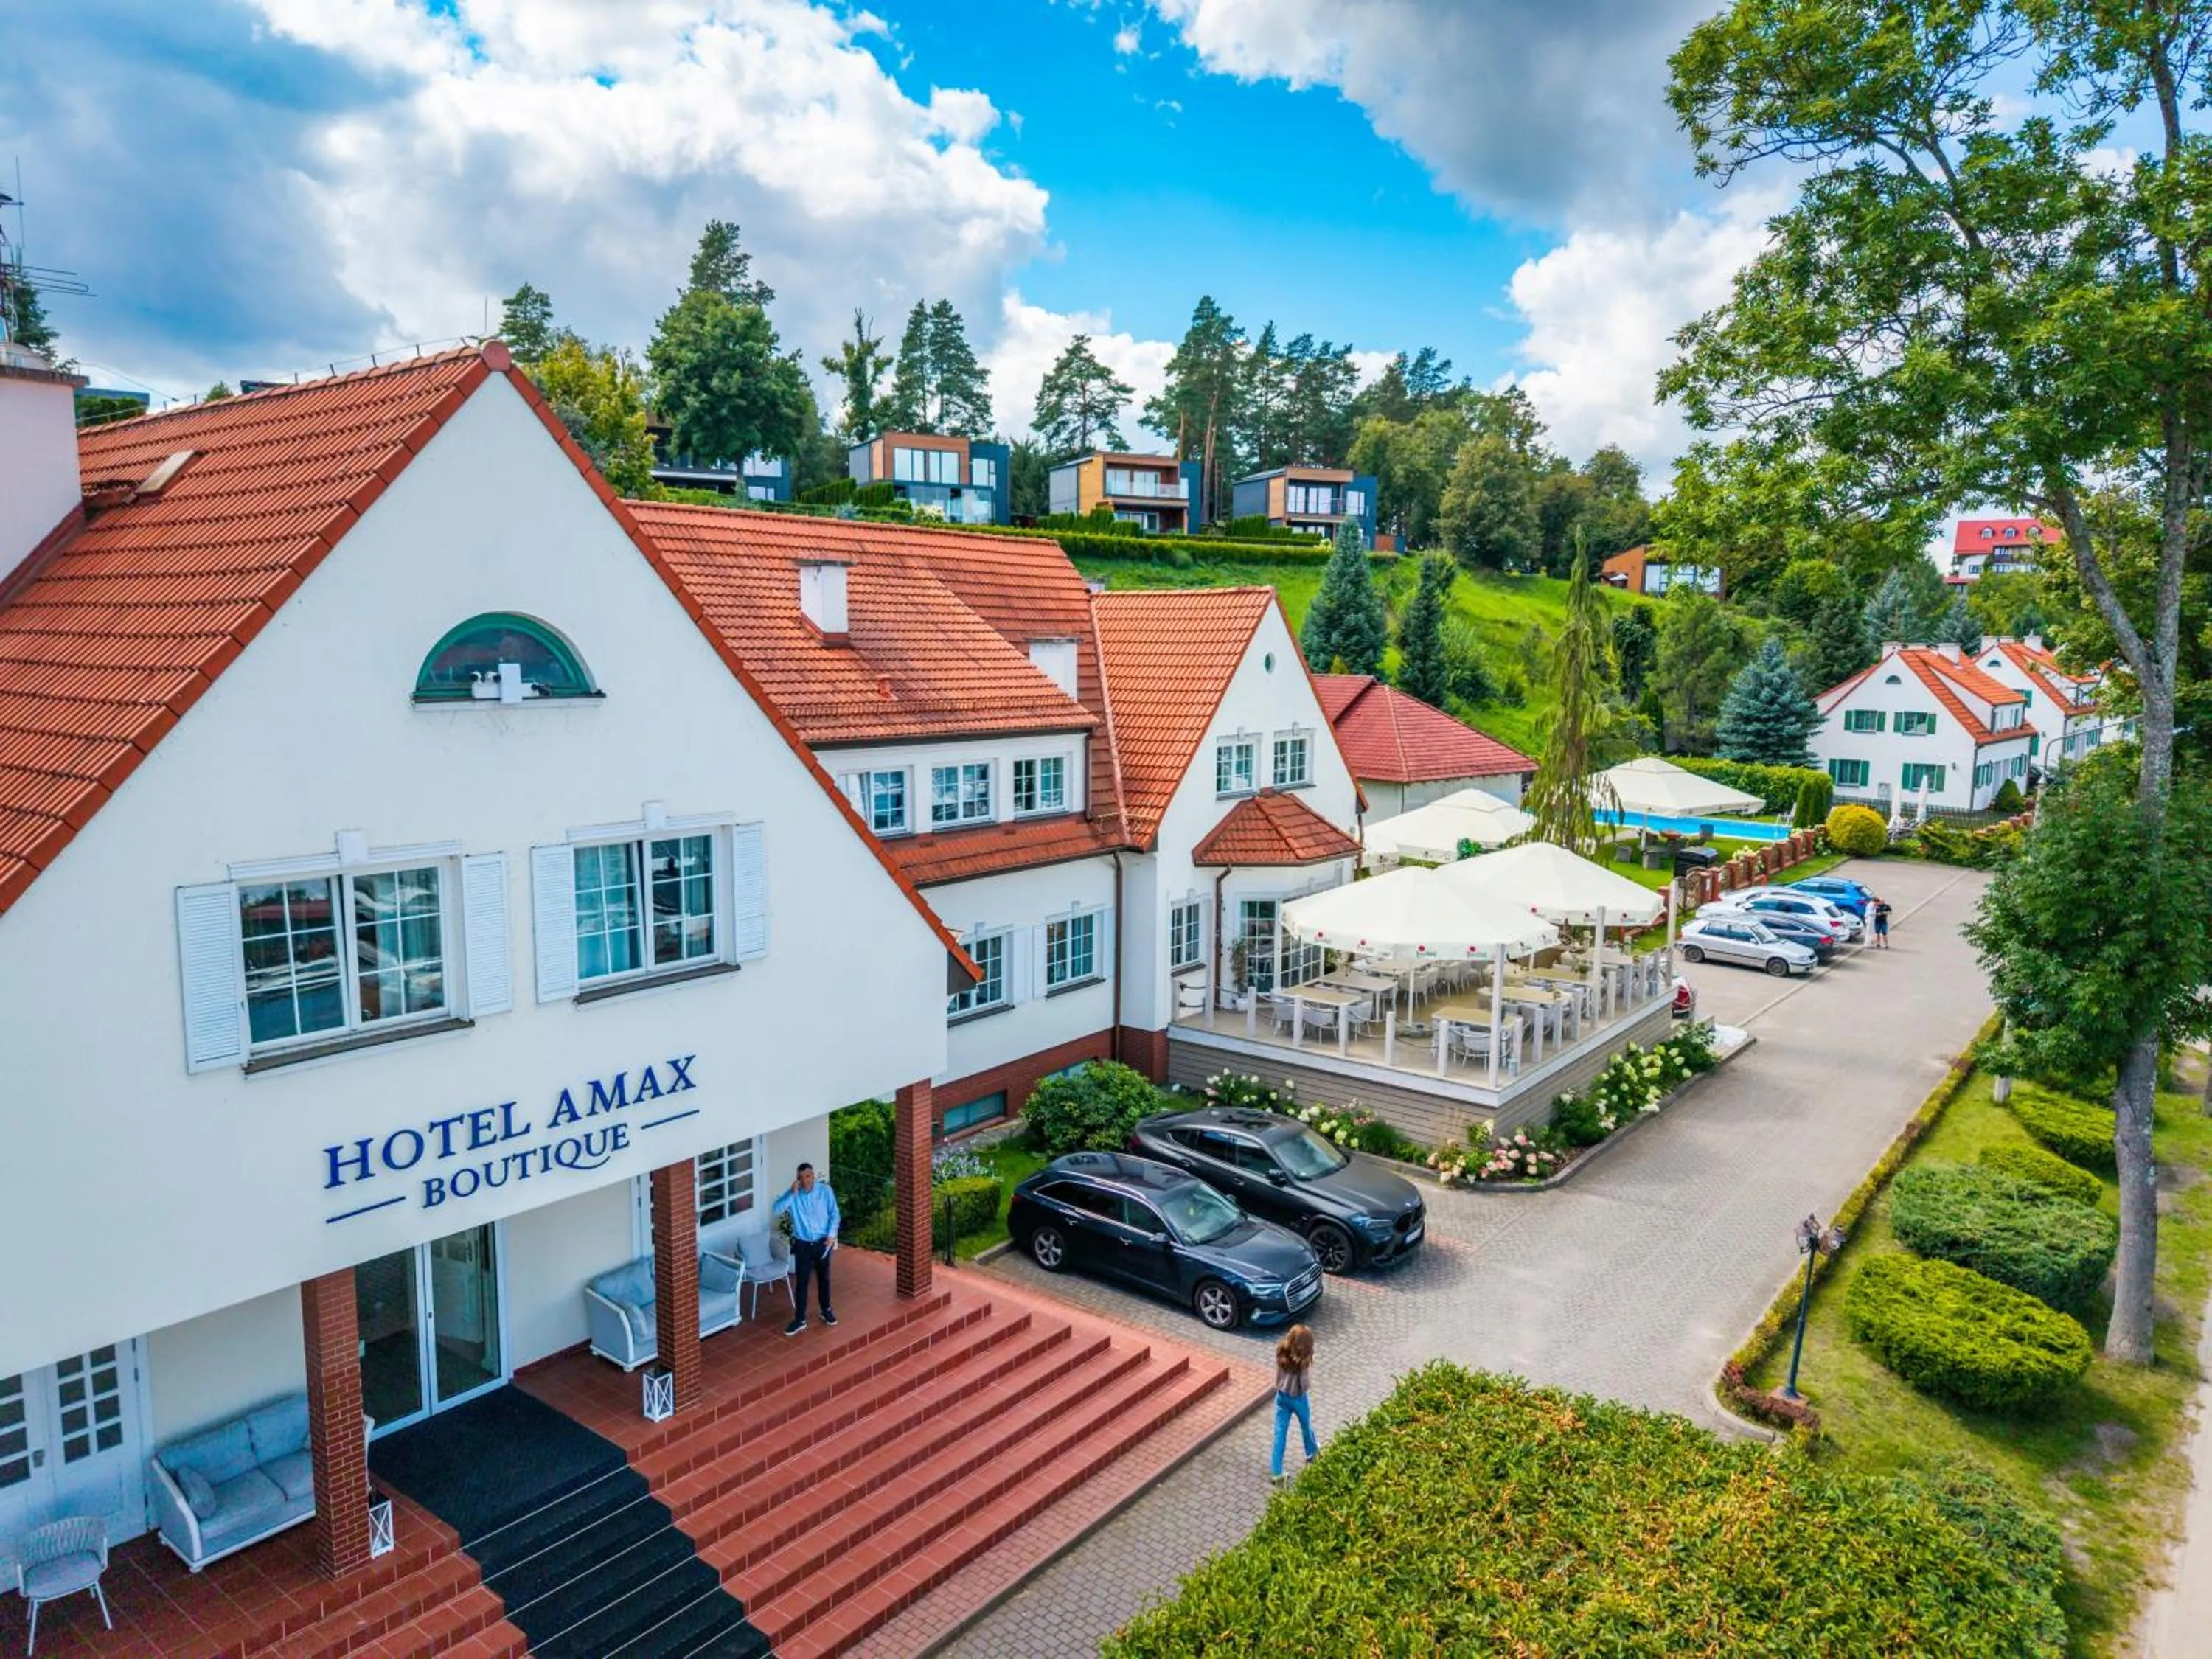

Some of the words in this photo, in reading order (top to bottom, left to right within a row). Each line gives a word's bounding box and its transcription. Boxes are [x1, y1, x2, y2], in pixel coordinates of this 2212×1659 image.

[323, 1101, 532, 1189] HOTEL
[546, 1054, 698, 1129] AMAX
[422, 1123, 630, 1210] BOUTIQUE
